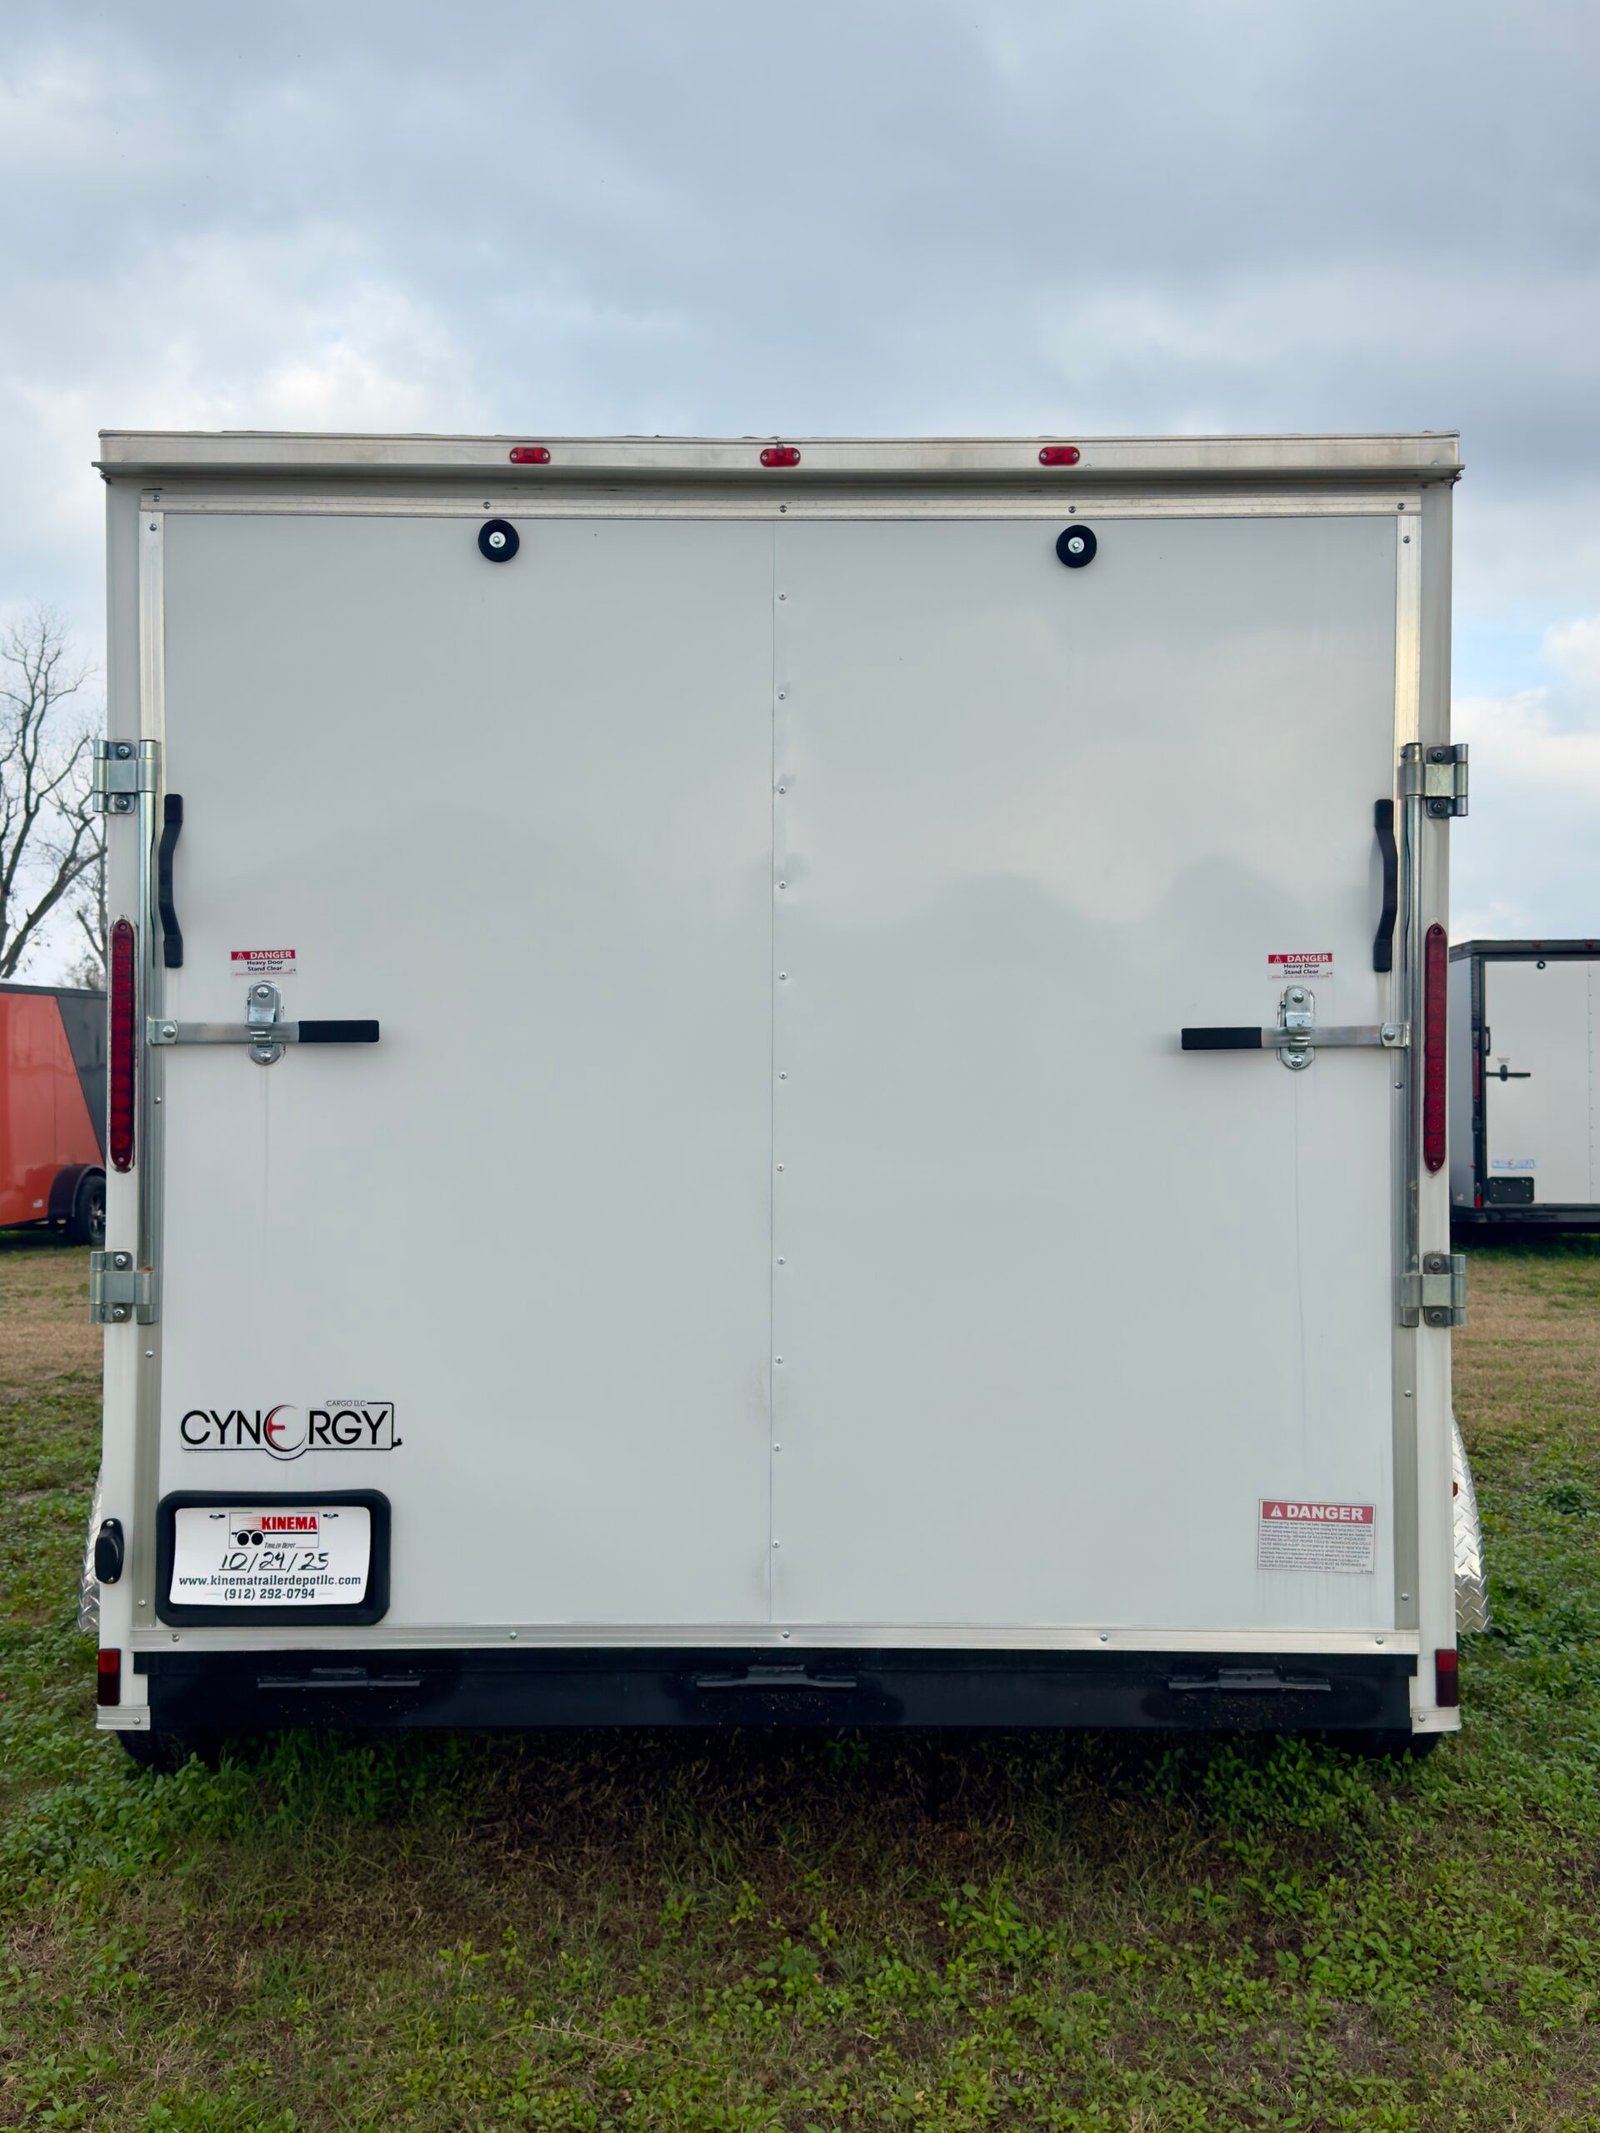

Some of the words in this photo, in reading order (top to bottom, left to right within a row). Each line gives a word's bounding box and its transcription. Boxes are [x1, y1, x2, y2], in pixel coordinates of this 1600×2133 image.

[250, 951, 292, 959] DANGER
[1287, 955, 1329, 963] DANGER
[181, 1404, 389, 1452] CYNERGY
[1287, 1504, 1364, 1521] DANGER
[261, 1516, 317, 1530] KINEMA
[179, 1575, 361, 1587] www.kinematrailerdepotllc.com
[224, 1588, 256, 1600] (912)
[259, 1588, 315, 1599] 292-0794
